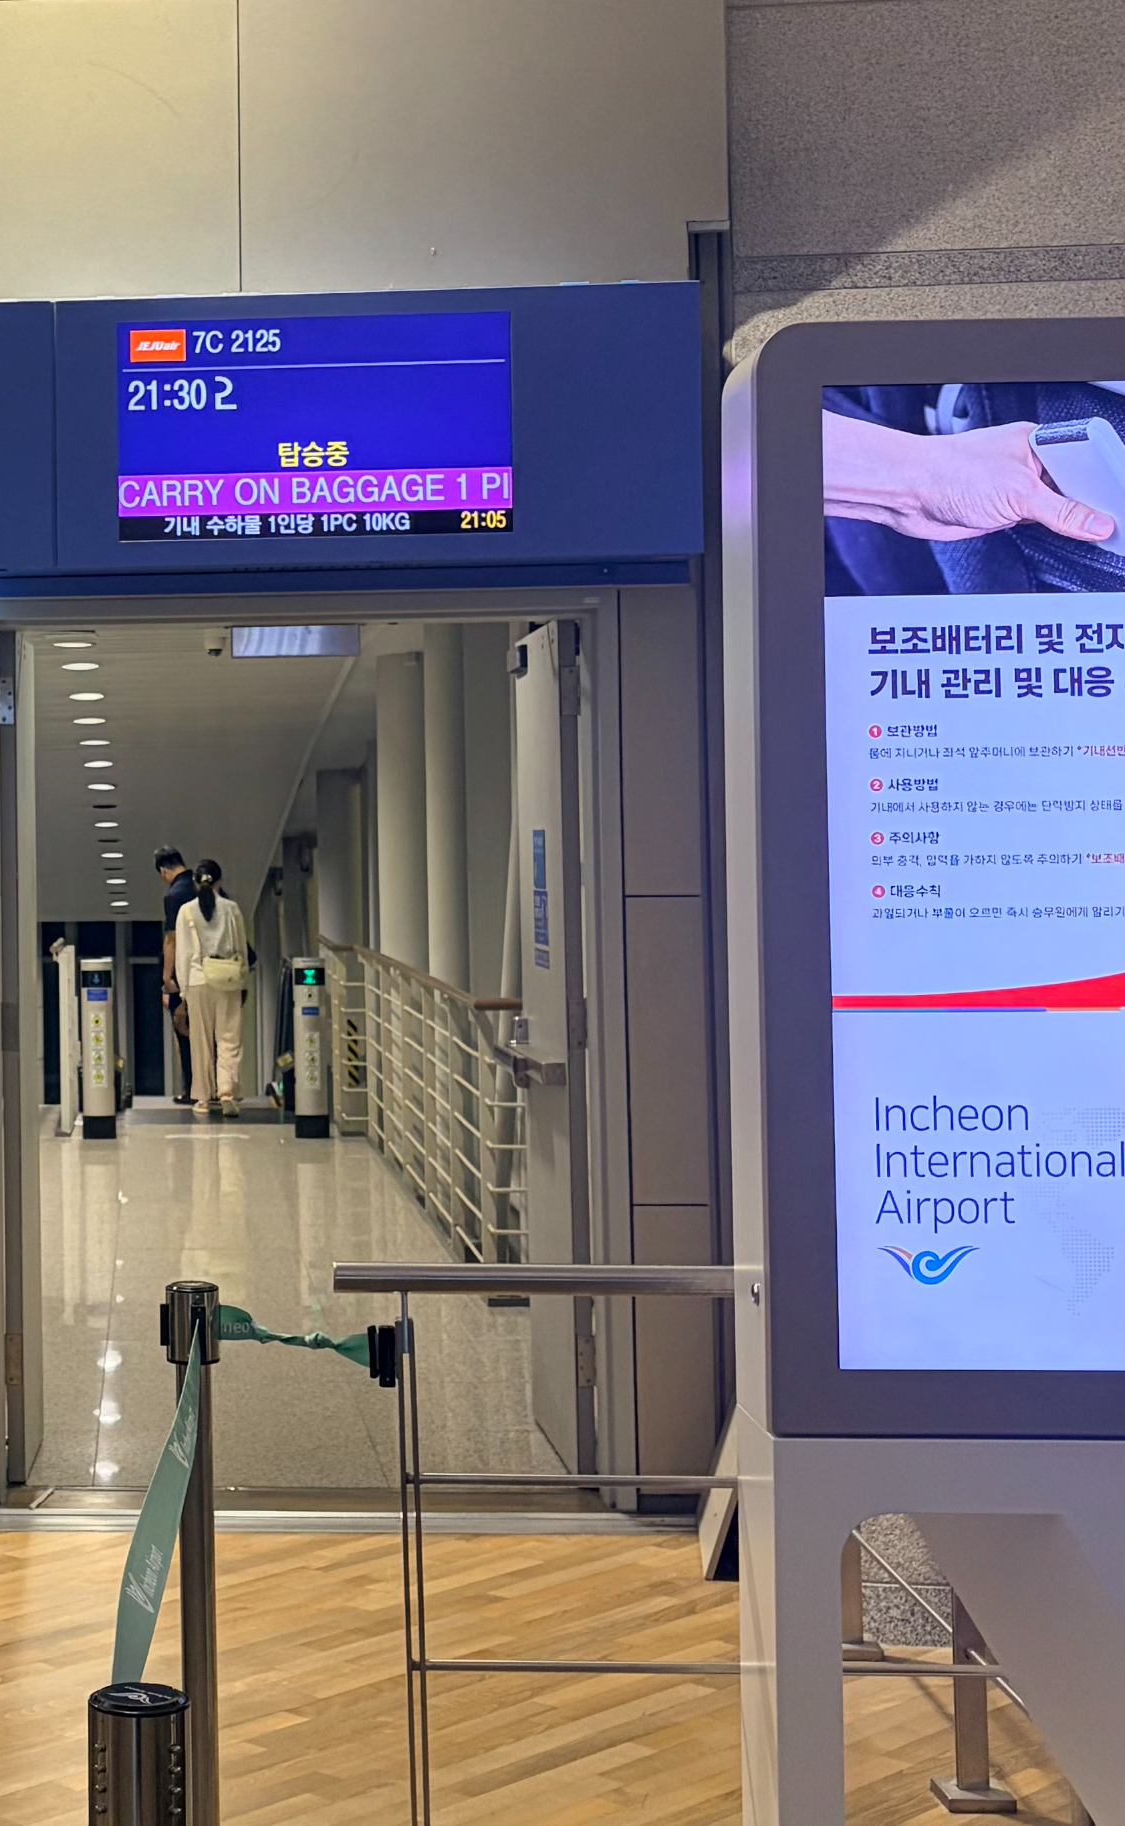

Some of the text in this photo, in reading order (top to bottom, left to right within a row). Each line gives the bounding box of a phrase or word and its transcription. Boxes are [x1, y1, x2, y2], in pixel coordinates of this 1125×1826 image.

[192, 330, 223, 353] 7C
[231, 329, 281, 353] 2125
[128, 378, 207, 411] 21:30
[278, 441, 350, 468] 탑승중
[118, 472, 509, 508] CARRY ON BAGGAGE 1 PI
[163, 512, 411, 536] 기내 수하물 1인당 1PC 10KG
[460, 510, 507, 530] 21:05
[868, 623, 1023, 655] 보조배터리
[1035, 622, 1064, 654] 및
[870, 668, 931, 699] 기내
[940, 667, 1001, 699] 관리
[1014, 667, 1043, 698] 및
[1053, 666, 1115, 697] 대응
[887, 724, 938, 738] 보관방법
[895, 747, 940, 759] 지니거나
[1029, 746, 1074, 758] 보관하기
[888, 778, 939, 791] 사용방법
[870, 802, 915, 813] 기내에서
[994, 800, 1037, 812] 경우에는
[889, 831, 940, 845] 주의사항
[963, 854, 996, 865] 가하지
[1037, 853, 1082, 865] 주의하기
[890, 884, 941, 898] 대응수칙
[1032, 906, 1088, 918] 승무원에게
[875, 1095, 1029, 1131] Incheon
[876, 1140, 1125, 1178] International
[875, 1189, 1015, 1234] Airport
